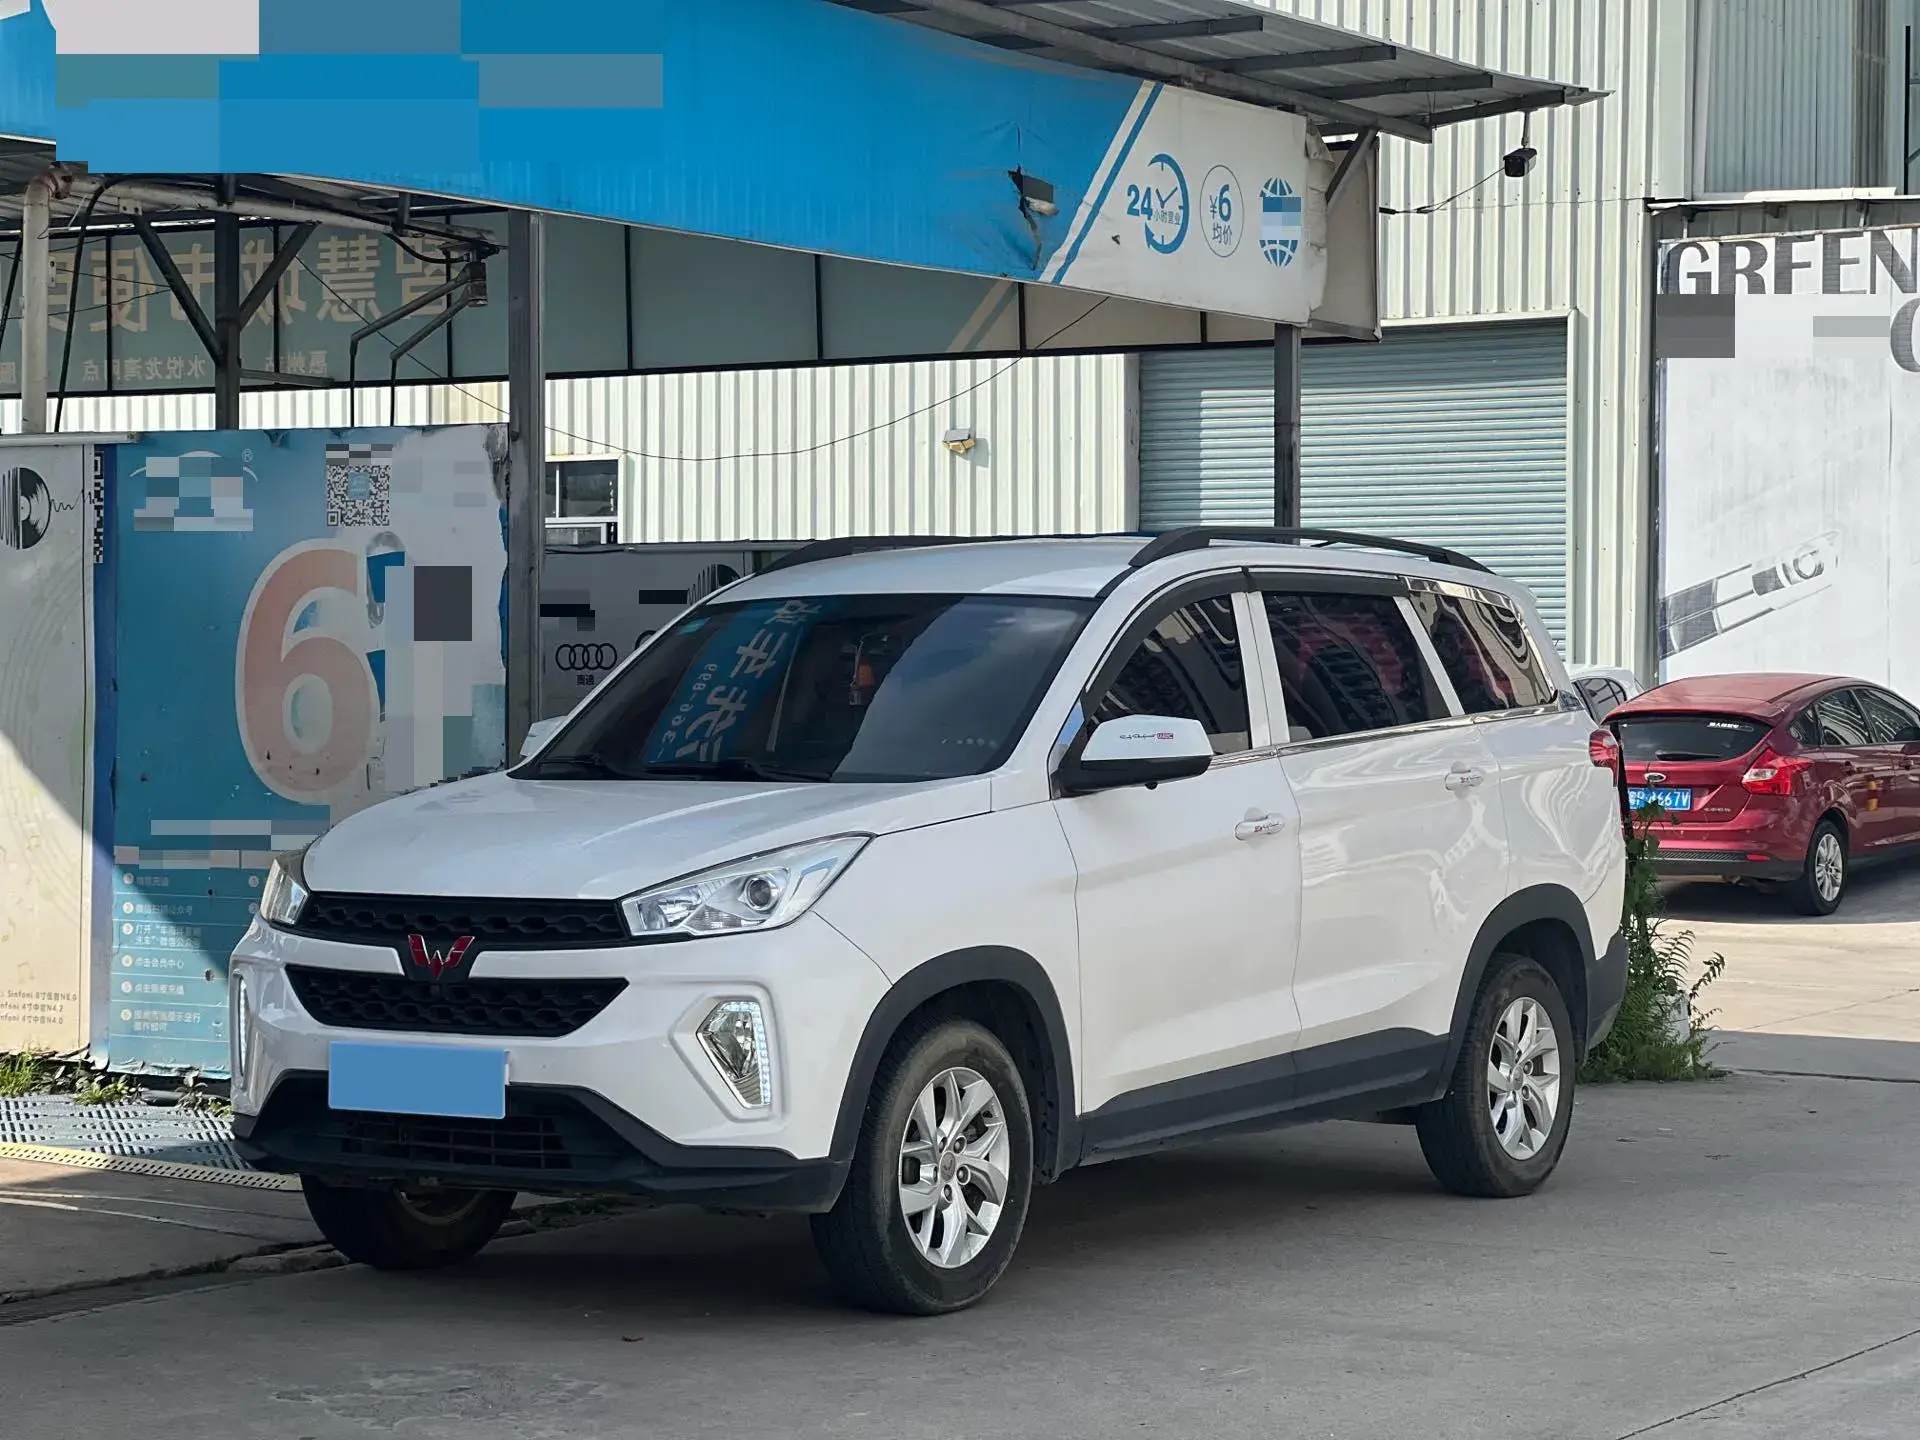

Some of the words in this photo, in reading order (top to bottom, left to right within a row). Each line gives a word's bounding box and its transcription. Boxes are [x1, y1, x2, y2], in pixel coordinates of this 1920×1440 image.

[1127, 184, 1153, 221] 24
[1209, 184, 1231, 222] ¥6
[1212, 222, 1232, 246] 均价
[236, 538, 380, 804] 6
